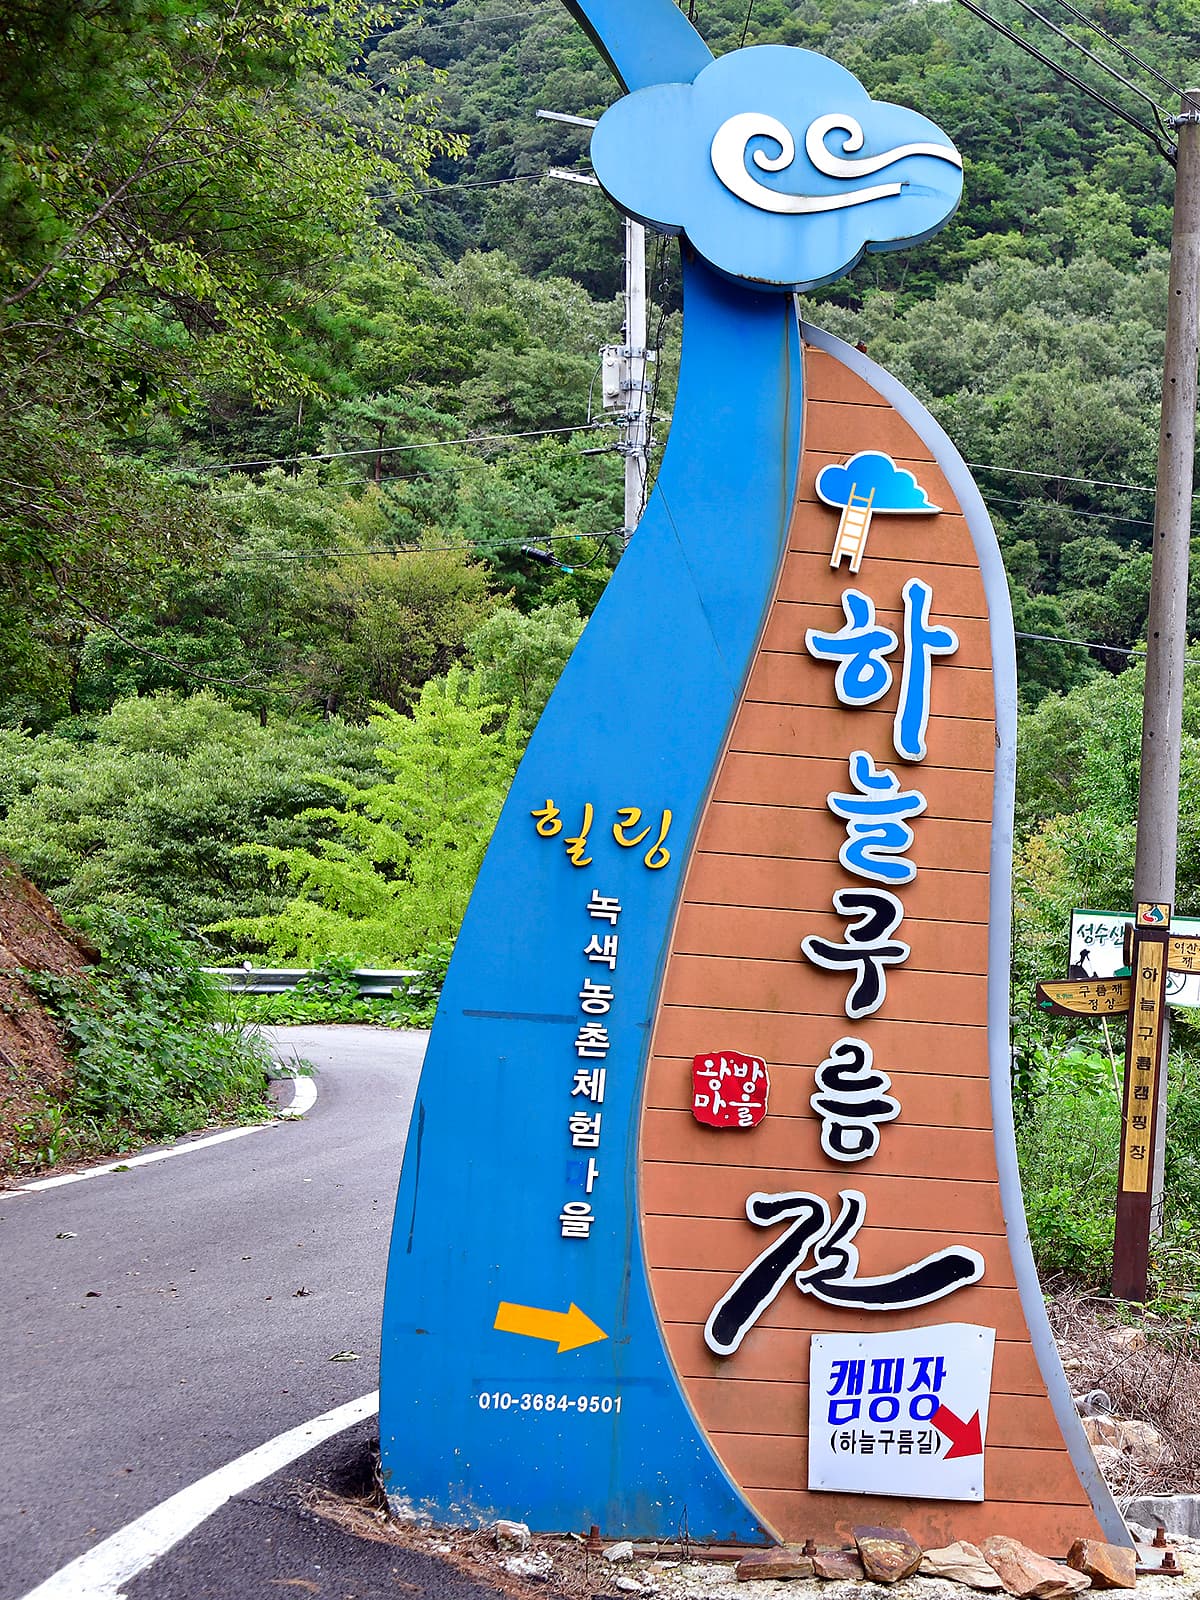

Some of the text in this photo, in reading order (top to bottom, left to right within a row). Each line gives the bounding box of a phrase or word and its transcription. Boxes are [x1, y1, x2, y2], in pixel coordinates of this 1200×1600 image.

[531, 799, 673, 869] 힐링
[1077, 923, 1125, 946] 성수산
[705, 577, 985, 1355] 하늘구름길
[559, 889, 622, 1239] 녹색농촌체험마을
[696, 1056, 764, 1094] 왕방
[1129, 967, 1159, 1160] 하늘구름캠핑장
[694, 1090, 762, 1127] 마을
[479, 1392, 622, 1413] 010-3684-9501
[826, 1356, 947, 1426] 캠핑장
[830, 1429, 941, 1455] (하늘구름길)
